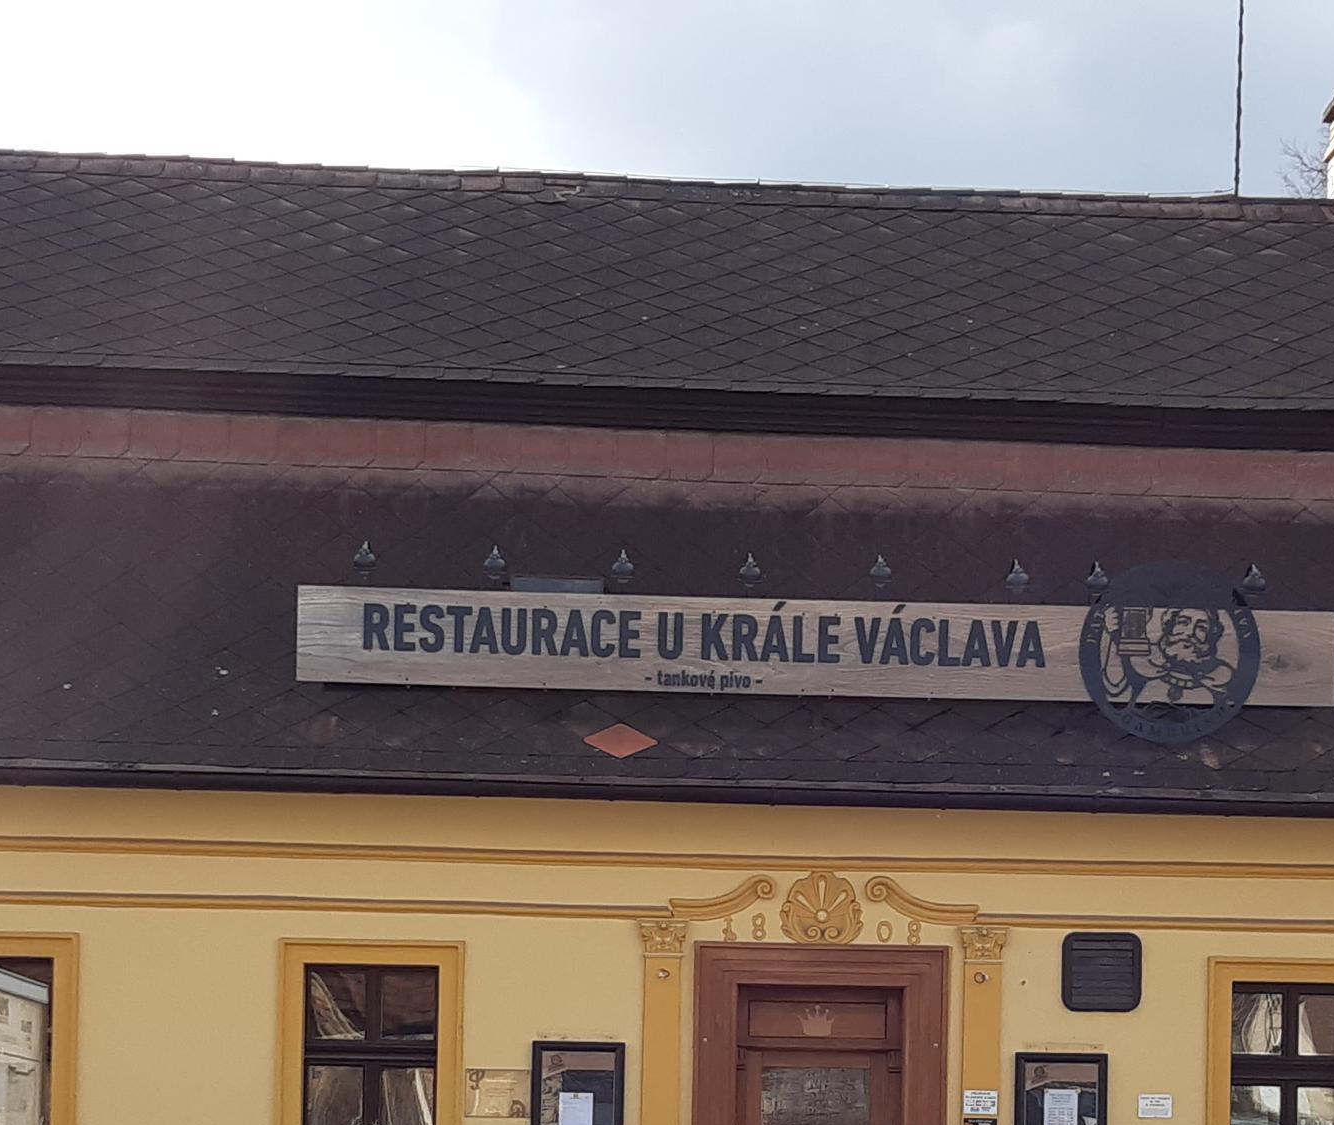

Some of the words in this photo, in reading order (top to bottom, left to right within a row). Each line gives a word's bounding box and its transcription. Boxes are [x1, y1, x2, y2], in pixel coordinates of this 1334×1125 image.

[362, 602, 643, 659] RESTAURACE
[657, 611, 684, 661] U
[700, 601, 842, 664] KRÁLE
[854, 603, 1047, 669] VÁCLAVA
[657, 669, 717, 689] tankové
[720, 671, 752, 692] pivo
